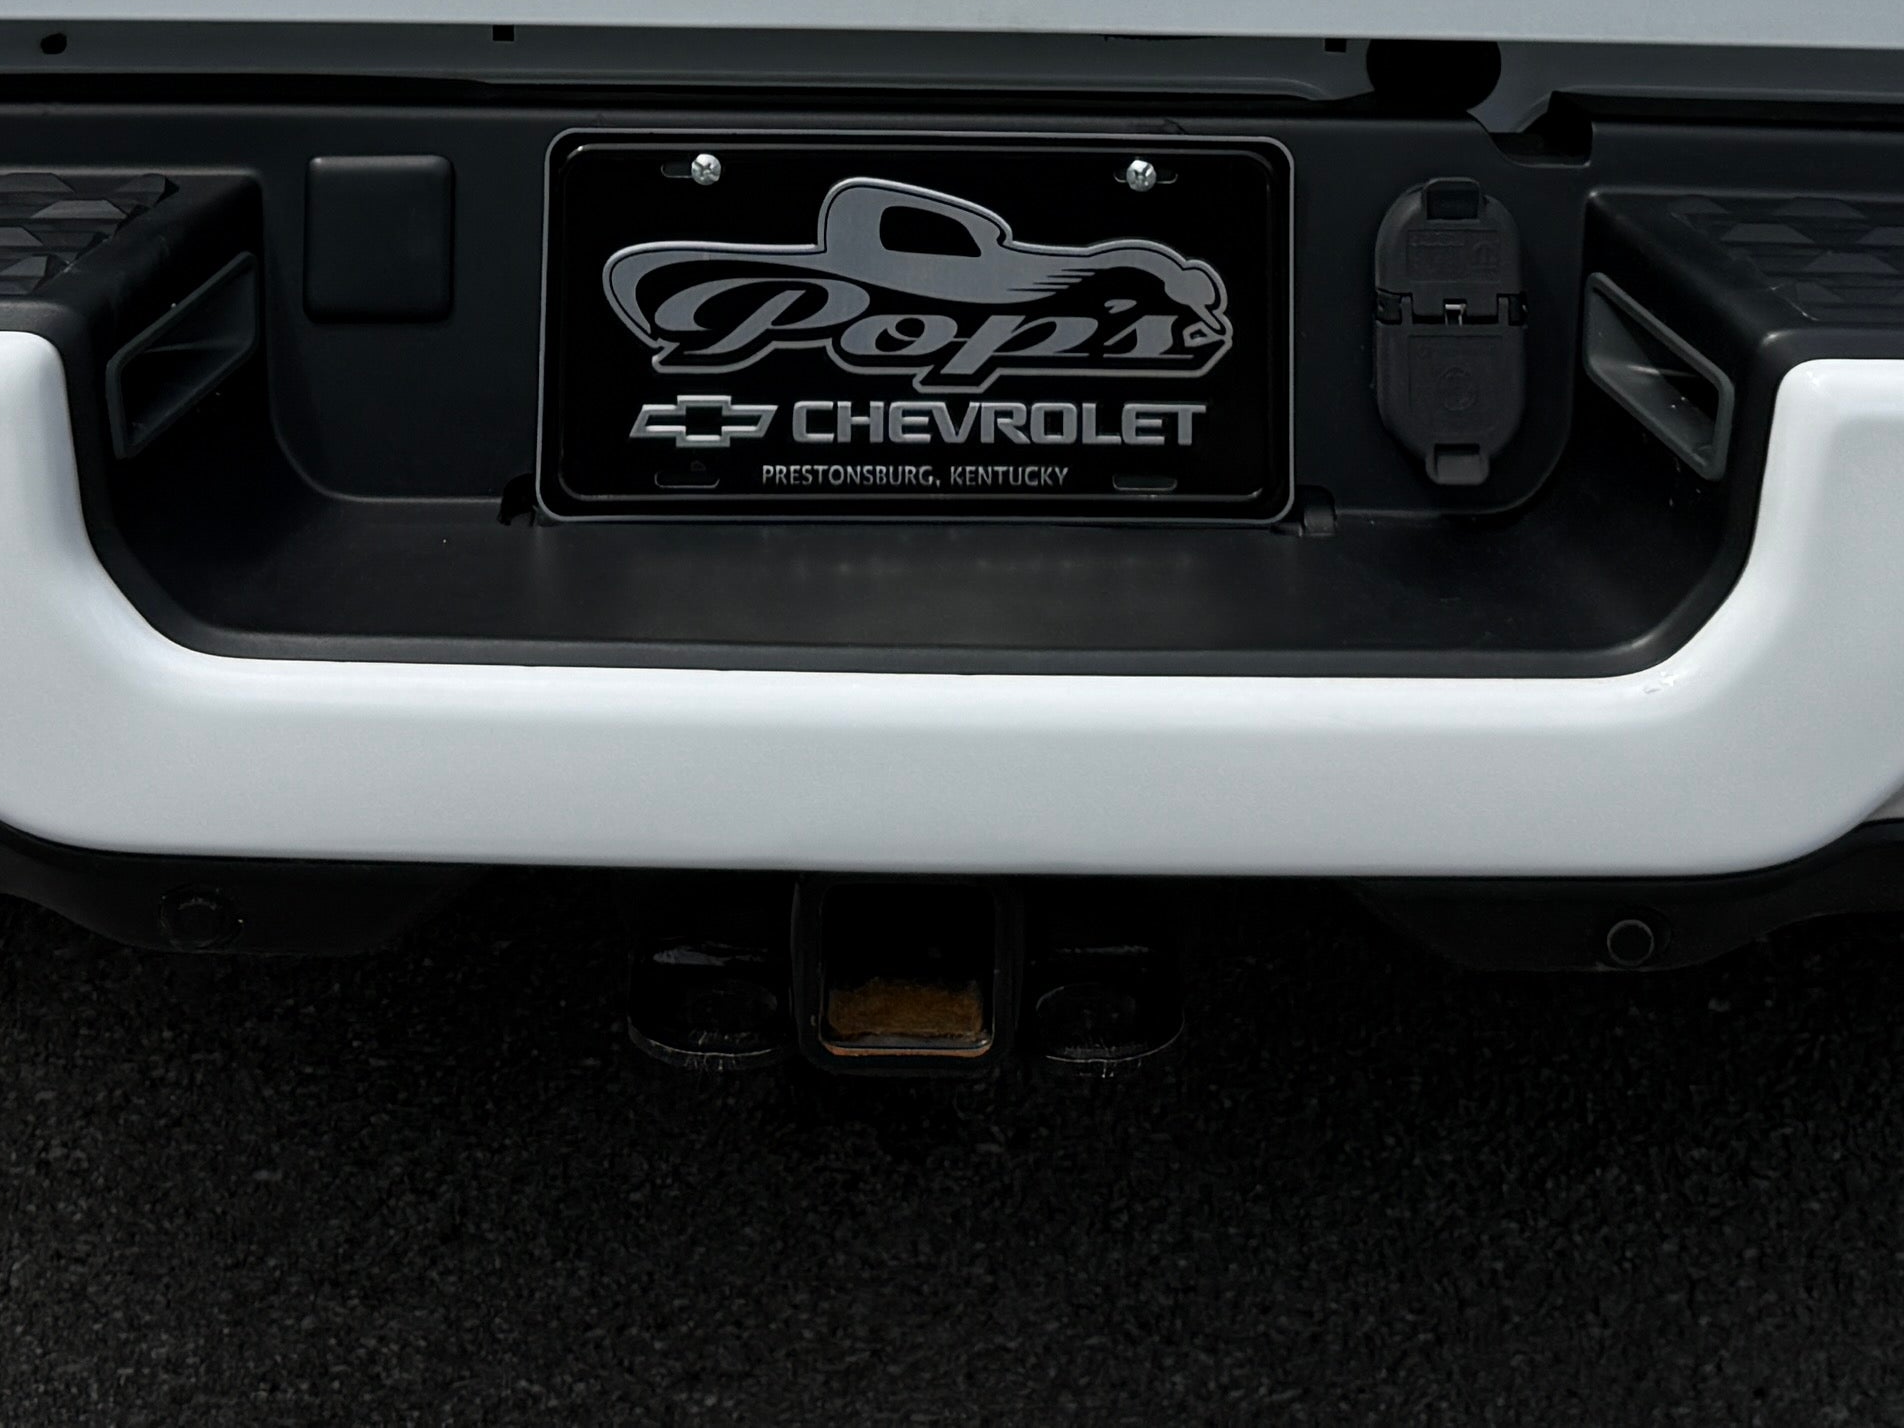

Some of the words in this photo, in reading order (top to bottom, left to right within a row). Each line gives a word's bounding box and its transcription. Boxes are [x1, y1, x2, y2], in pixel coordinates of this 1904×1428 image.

[653, 277, 1196, 382] Pop's
[791, 400, 1207, 445] CHEVROLET
[761, 464, 942, 488] PRESTONSBURG,
[949, 465, 1070, 488] KENTUCKY
